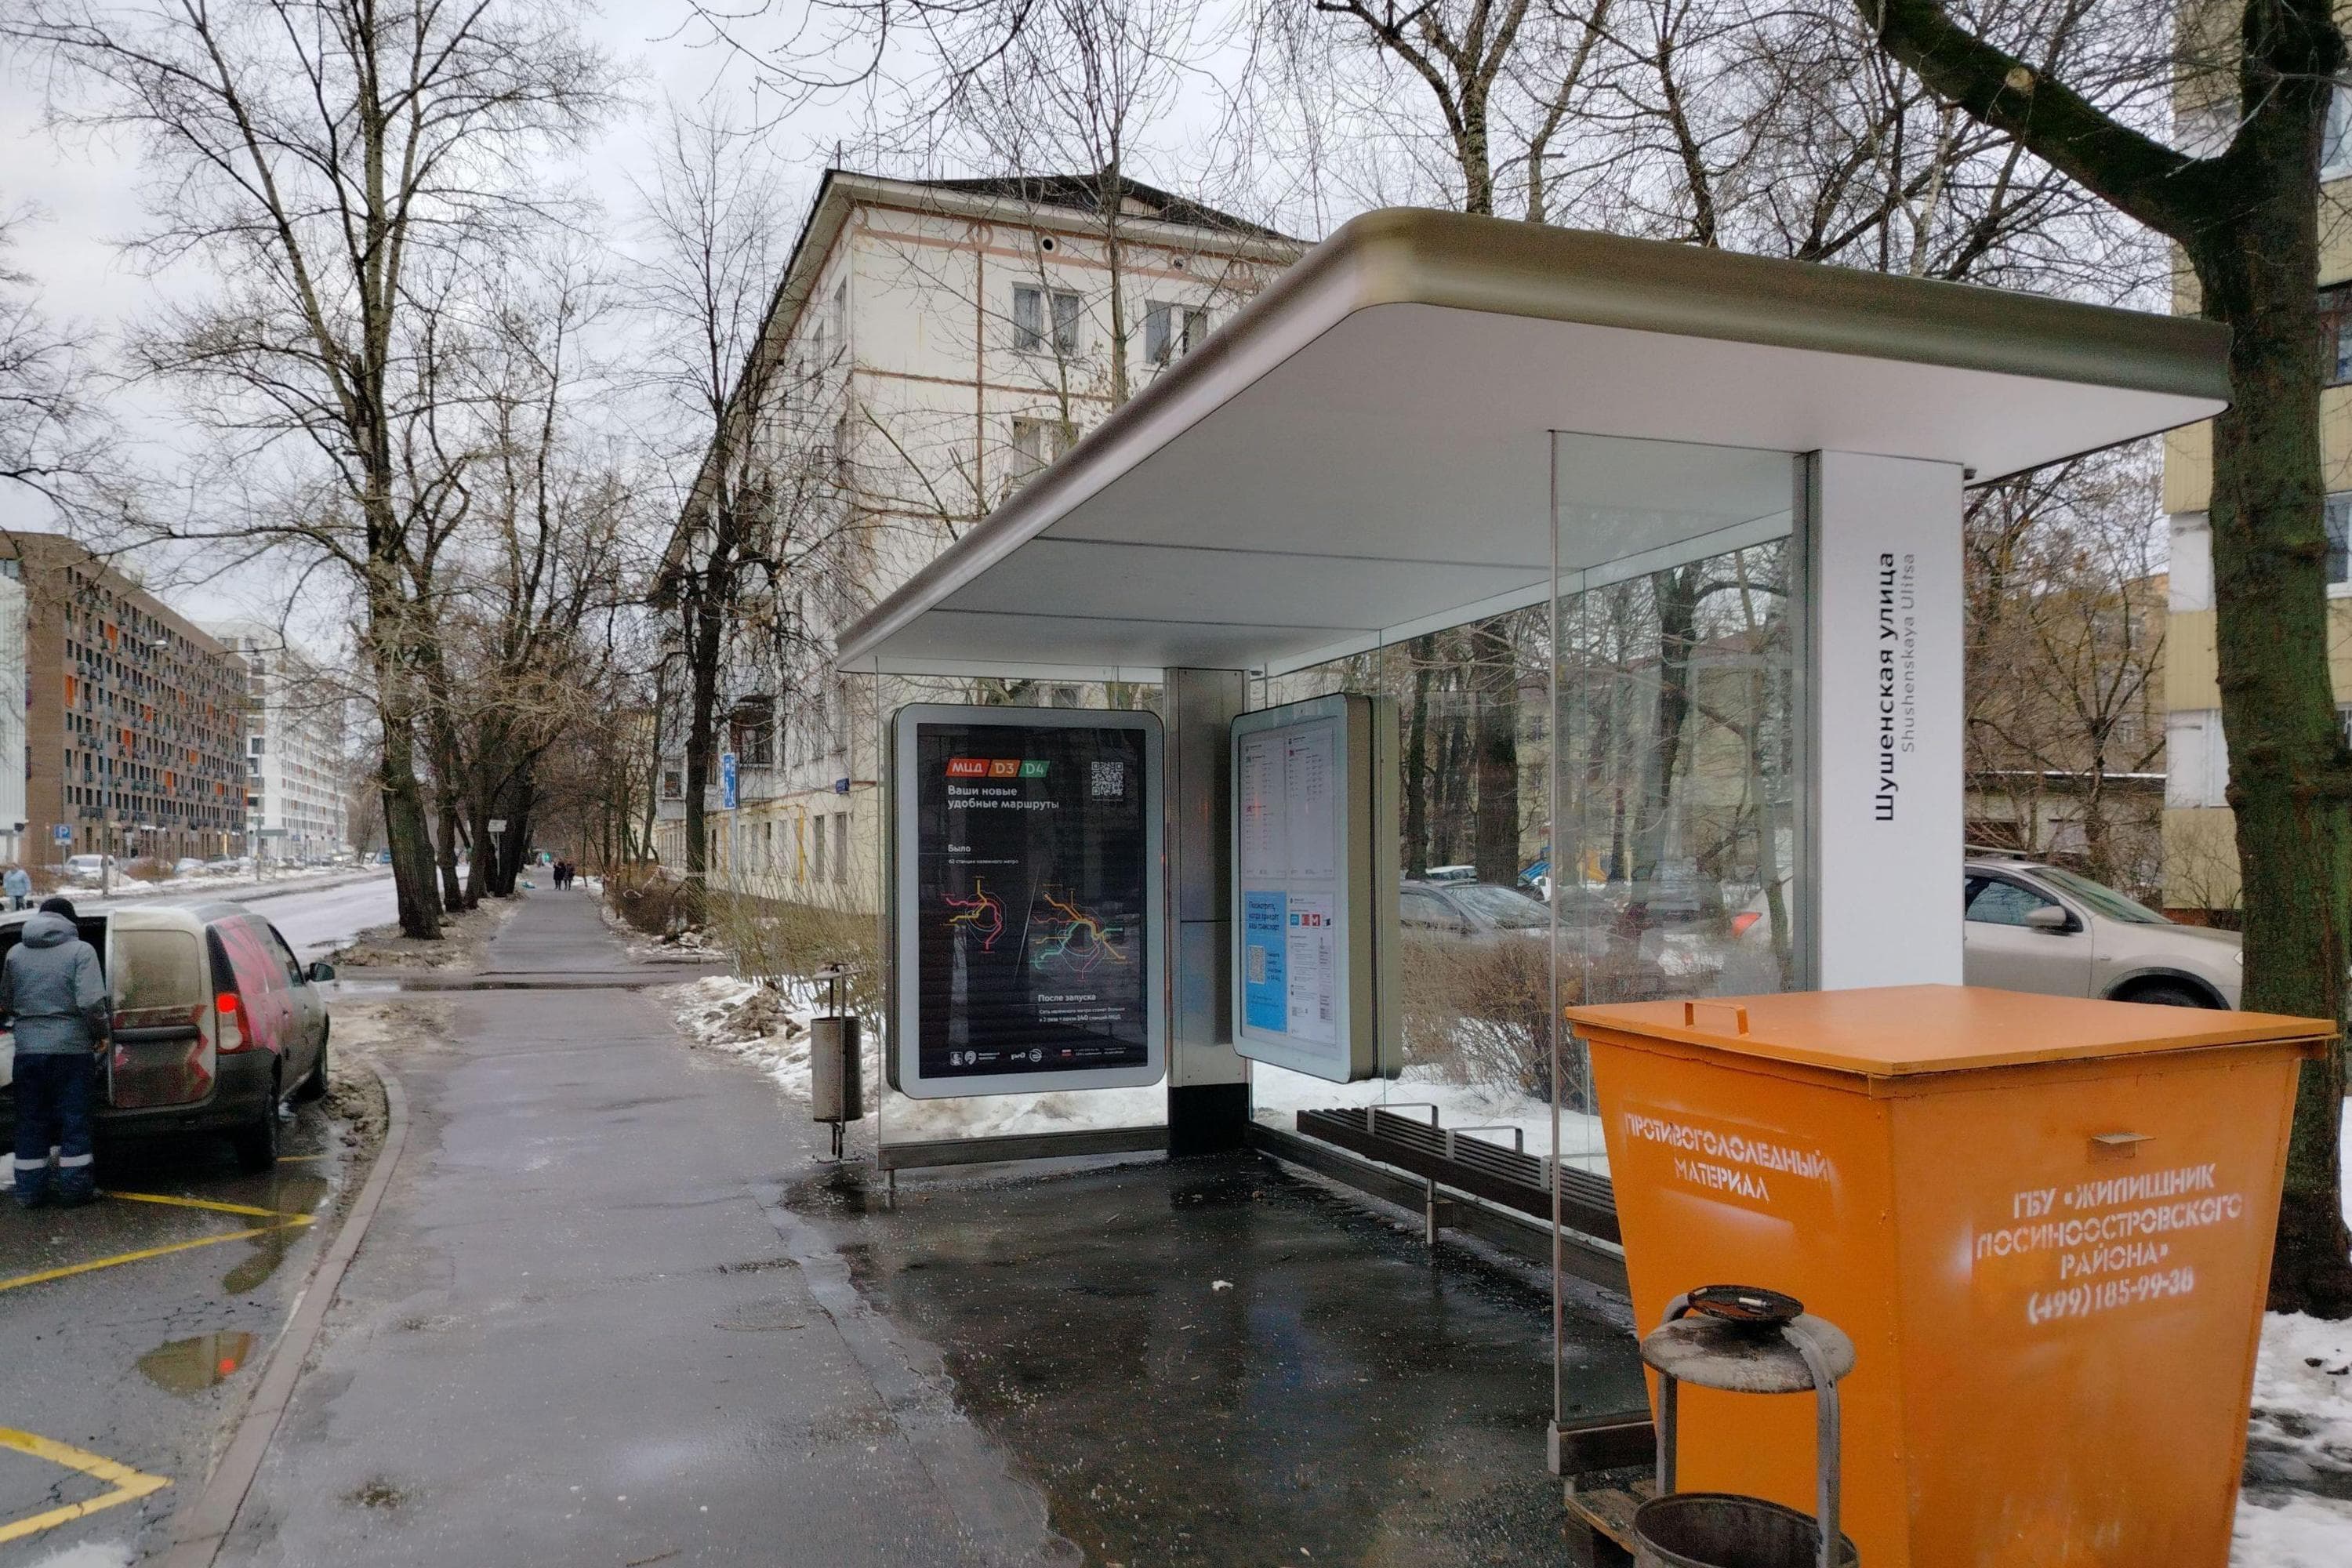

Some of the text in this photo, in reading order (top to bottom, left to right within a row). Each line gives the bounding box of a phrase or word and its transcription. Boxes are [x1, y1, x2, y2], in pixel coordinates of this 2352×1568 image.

[1900, 554, 1918, 753] Shushenskaya Ulitsa
[1875, 553, 1898, 821] Шушенская улица
[952, 763, 1044, 775] МЦД D3 D4
[948, 785, 1018, 796] Ваши новые
[948, 798, 1059, 811] удобные маршруты
[948, 844, 971, 852] Было
[1065, 993, 1096, 1003] запуска
[1624, 1112, 1832, 1181] ПРОТИВОГОЛОЛЕДНЫЙ
[1674, 1157, 1770, 1203] МАТЕРИАЛ
[2013, 1188, 2056, 1219] ГБУ
[1976, 1192, 2242, 1260] ЛОСИНООСТРОВСКОГО
